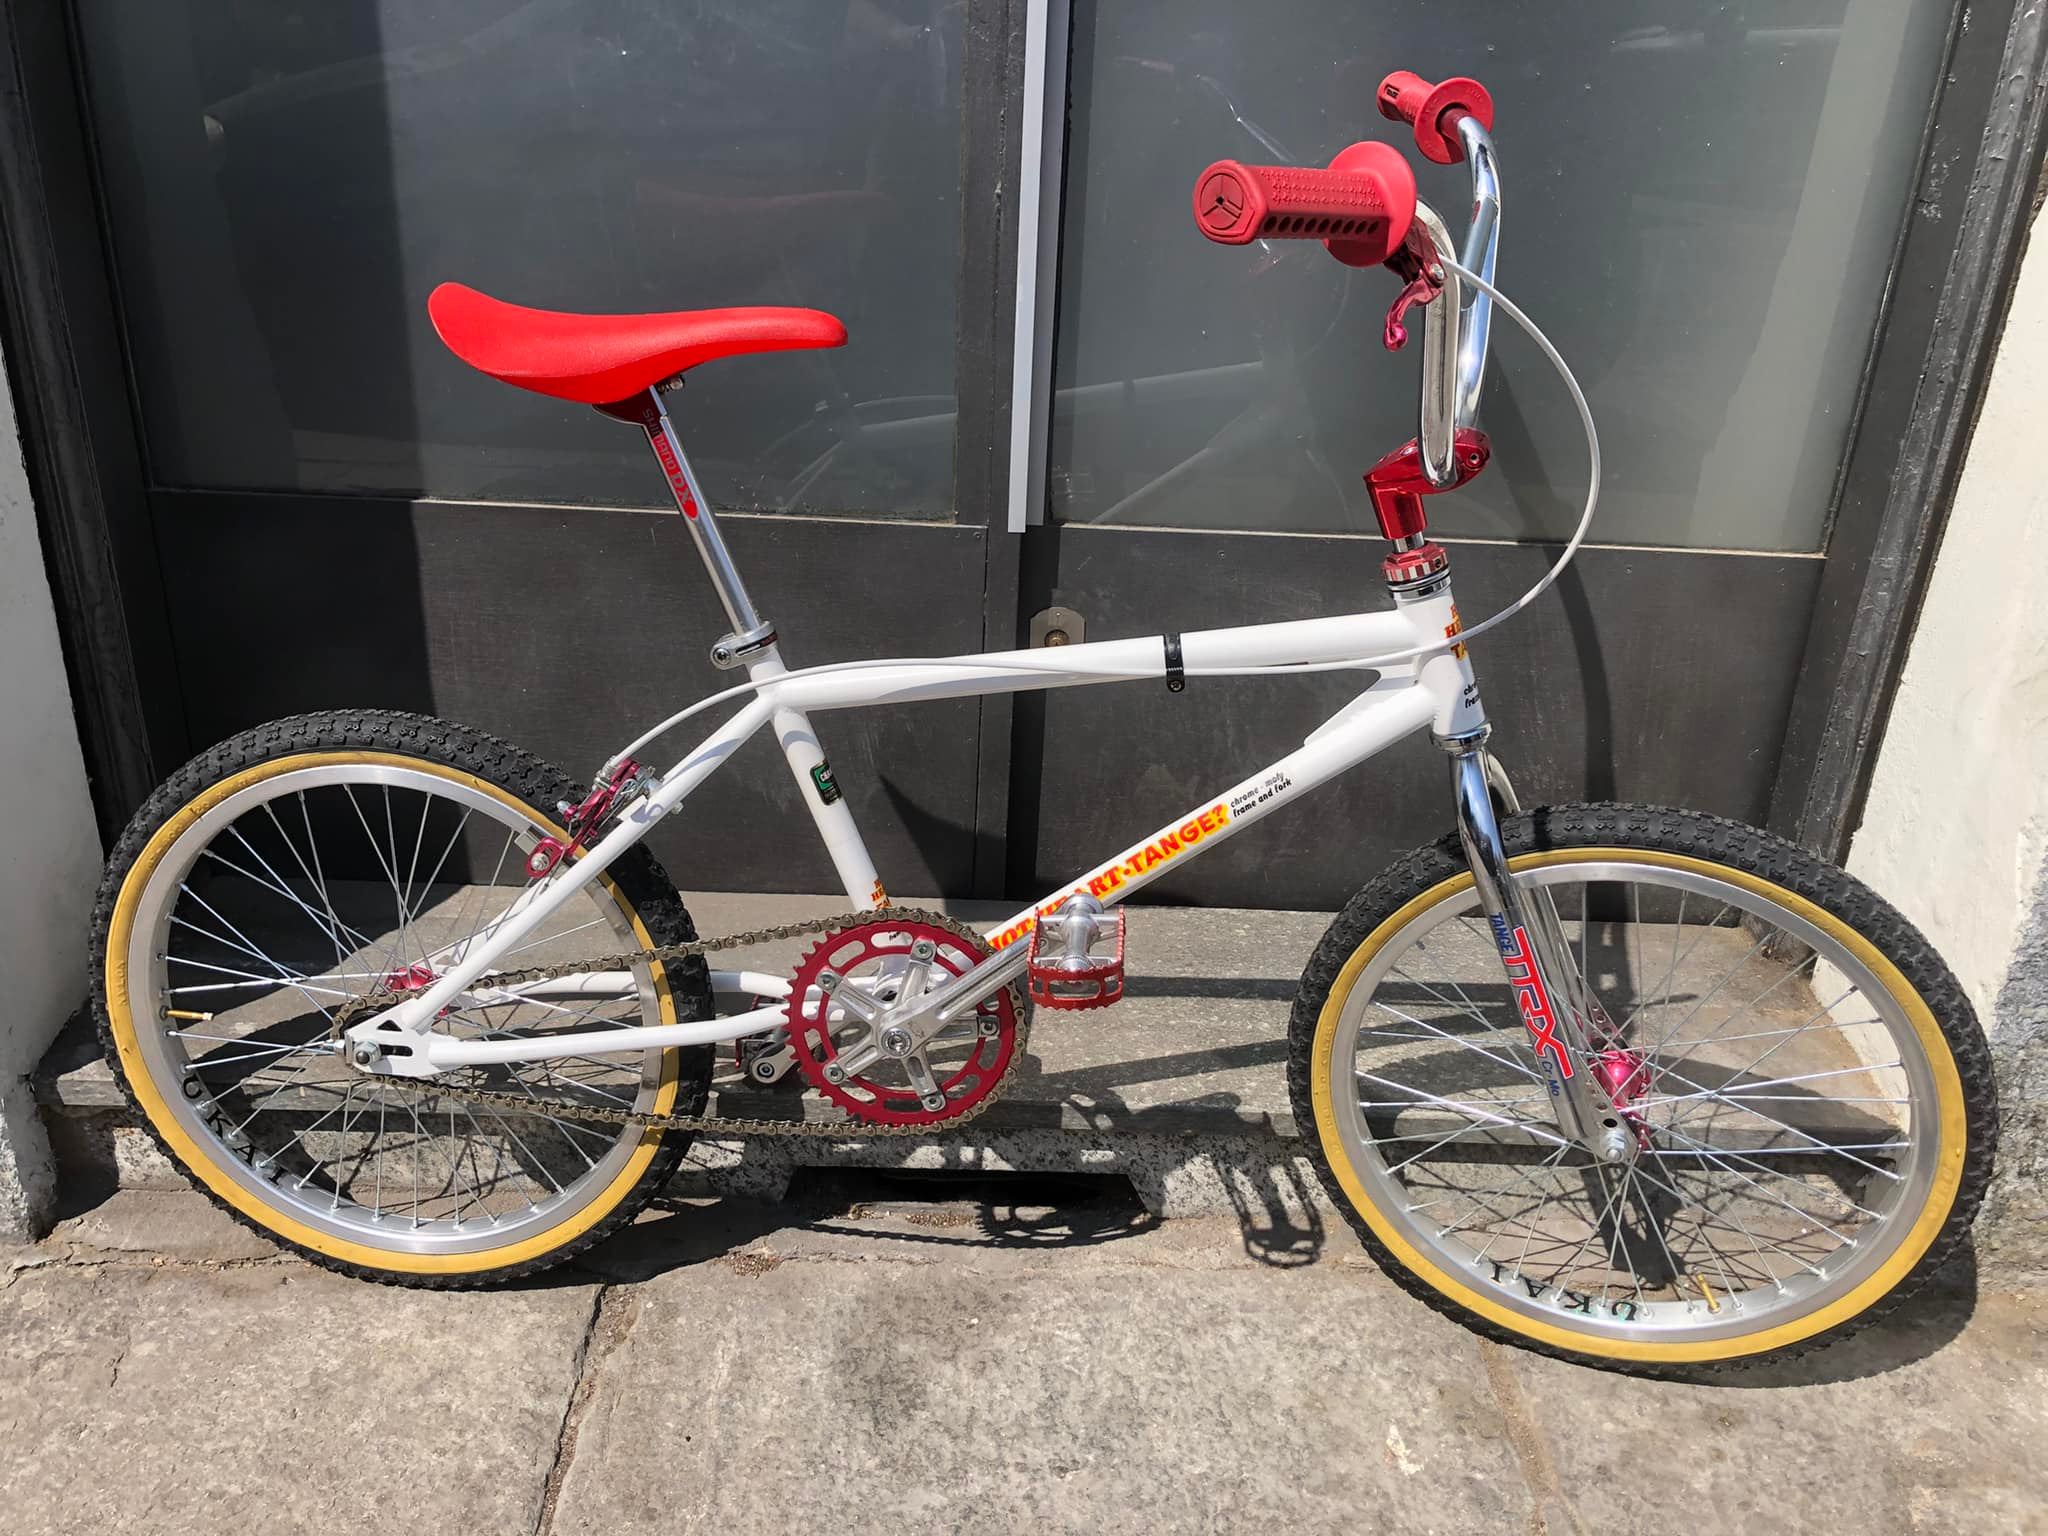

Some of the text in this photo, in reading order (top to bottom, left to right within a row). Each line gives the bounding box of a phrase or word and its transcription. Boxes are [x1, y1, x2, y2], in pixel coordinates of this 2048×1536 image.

[671, 472, 694, 504] DX
[1233, 778, 1292, 818] frame and fork
[1490, 911, 1514, 953] TANGE
[183, 1074, 289, 1186] UKAI
[1488, 1260, 1637, 1321] UKAI
